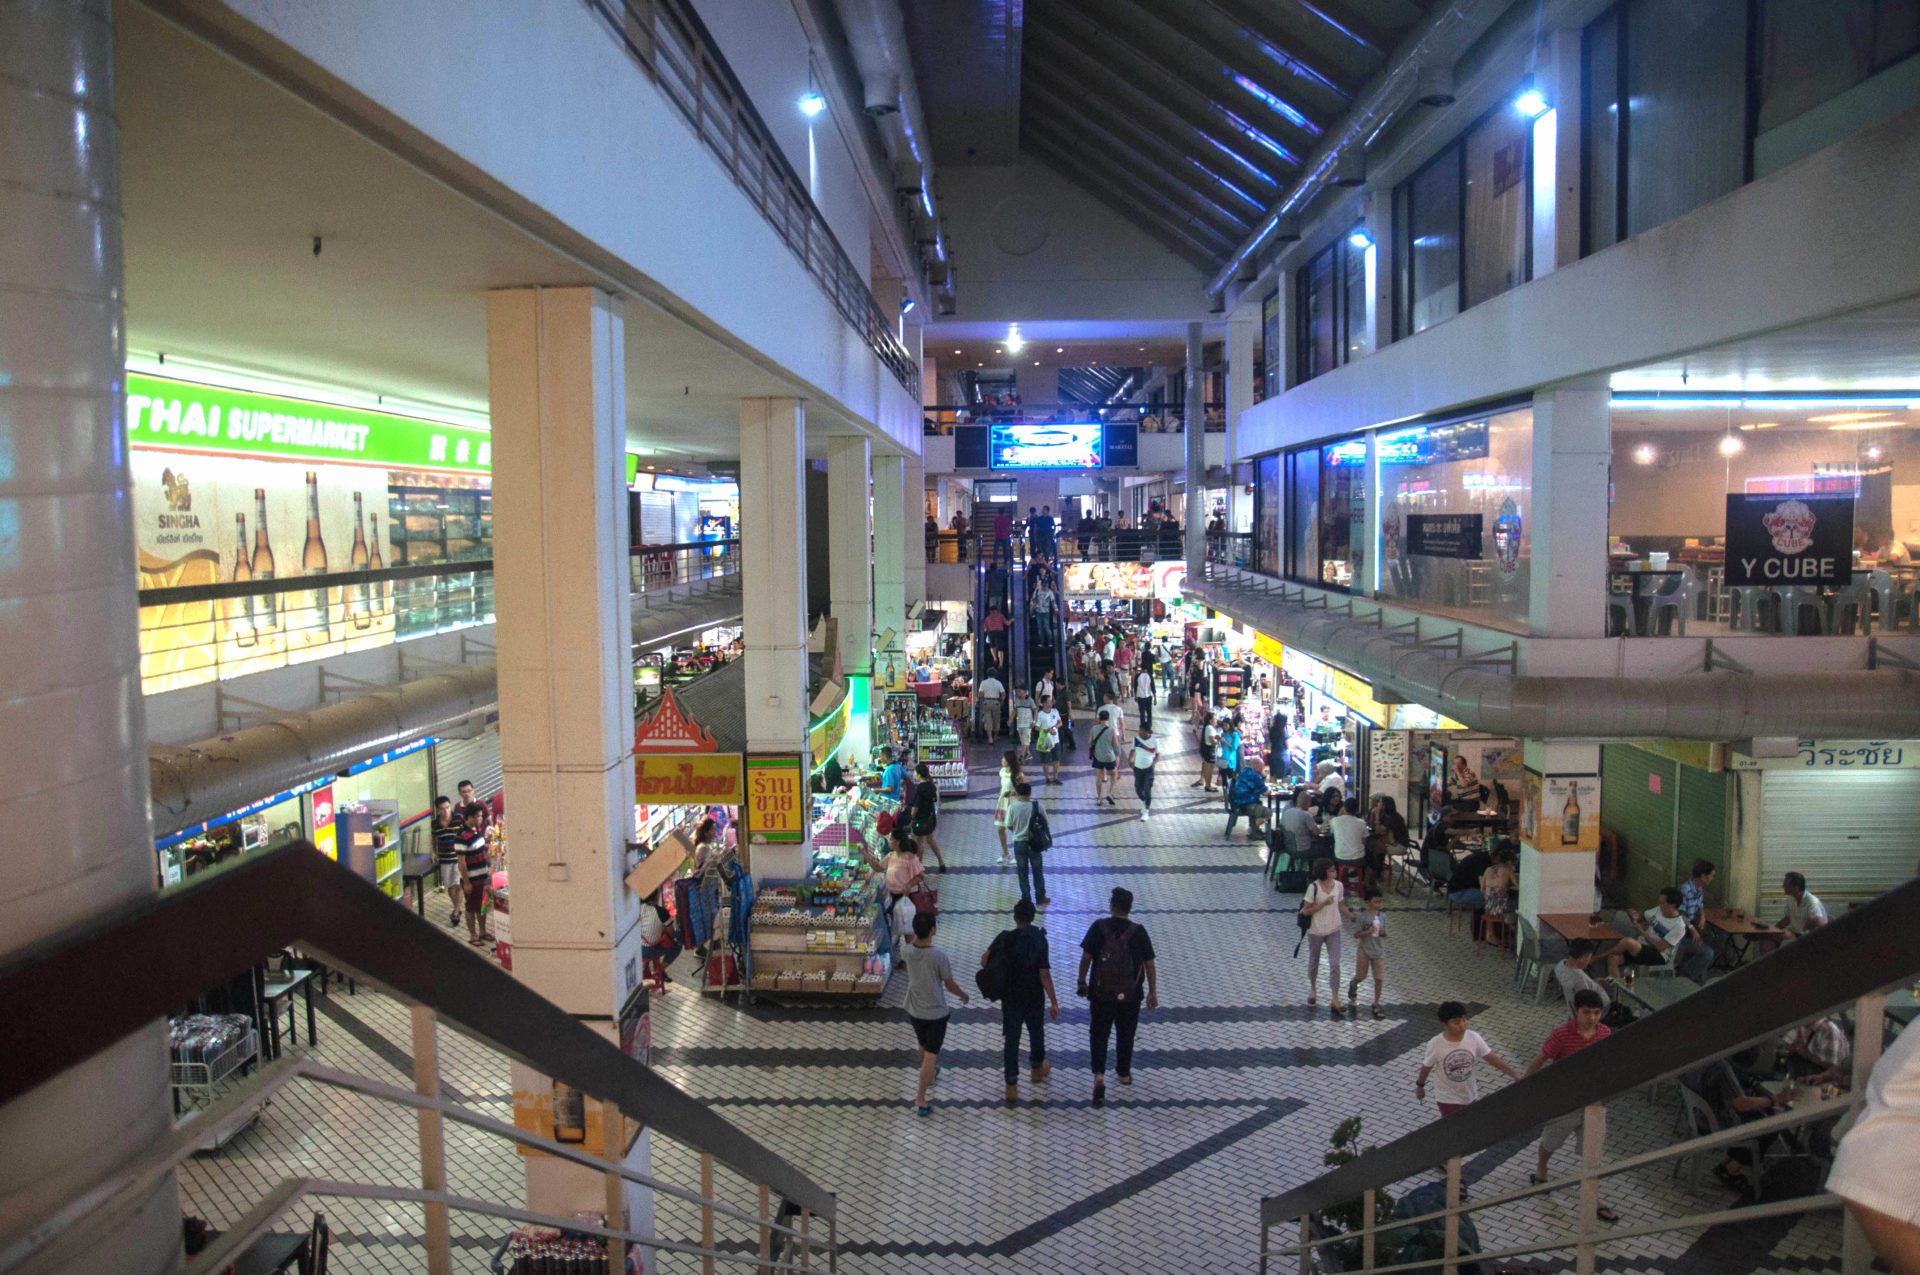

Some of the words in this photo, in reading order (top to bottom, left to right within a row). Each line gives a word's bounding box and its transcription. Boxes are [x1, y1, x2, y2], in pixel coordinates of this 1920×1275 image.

[126, 395, 221, 438] THAI
[227, 408, 370, 452] SUPERMARKET
[158, 514, 201, 529] SINGHA
[1741, 558, 1757, 578] Y
[1763, 558, 1836, 578] CUBE
[754, 771, 793, 795] ร้าน
[762, 812, 787, 829] ยา
